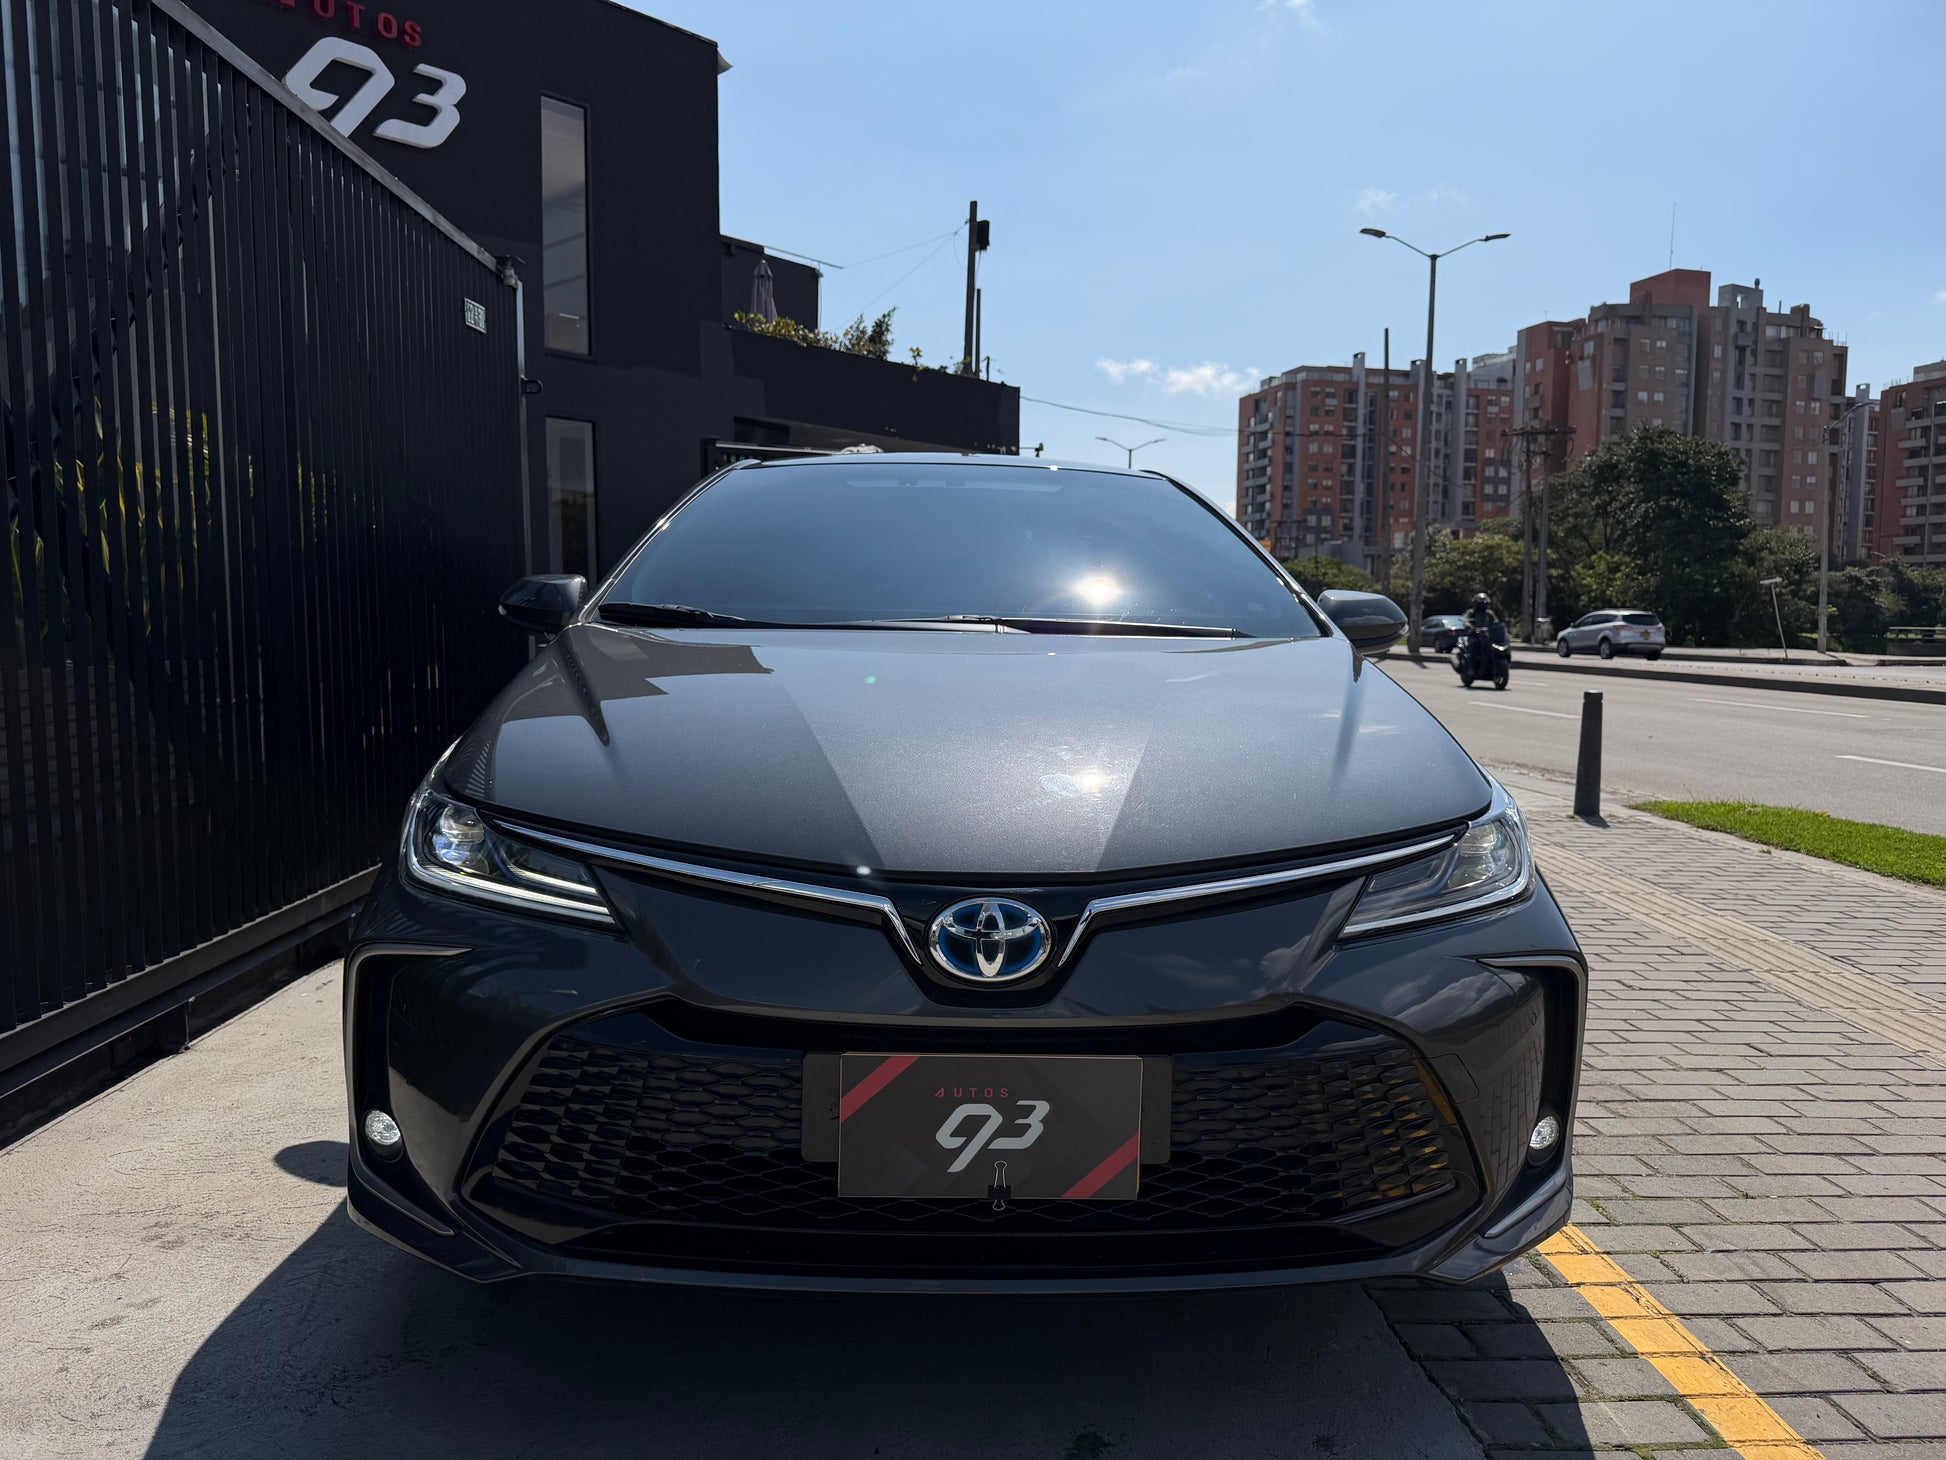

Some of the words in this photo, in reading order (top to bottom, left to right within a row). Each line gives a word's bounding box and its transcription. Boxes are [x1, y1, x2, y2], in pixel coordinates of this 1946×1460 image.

[282, 36, 467, 149] 93
[934, 1087, 1009, 1098] AUTOS
[935, 1100, 1050, 1173] 93
